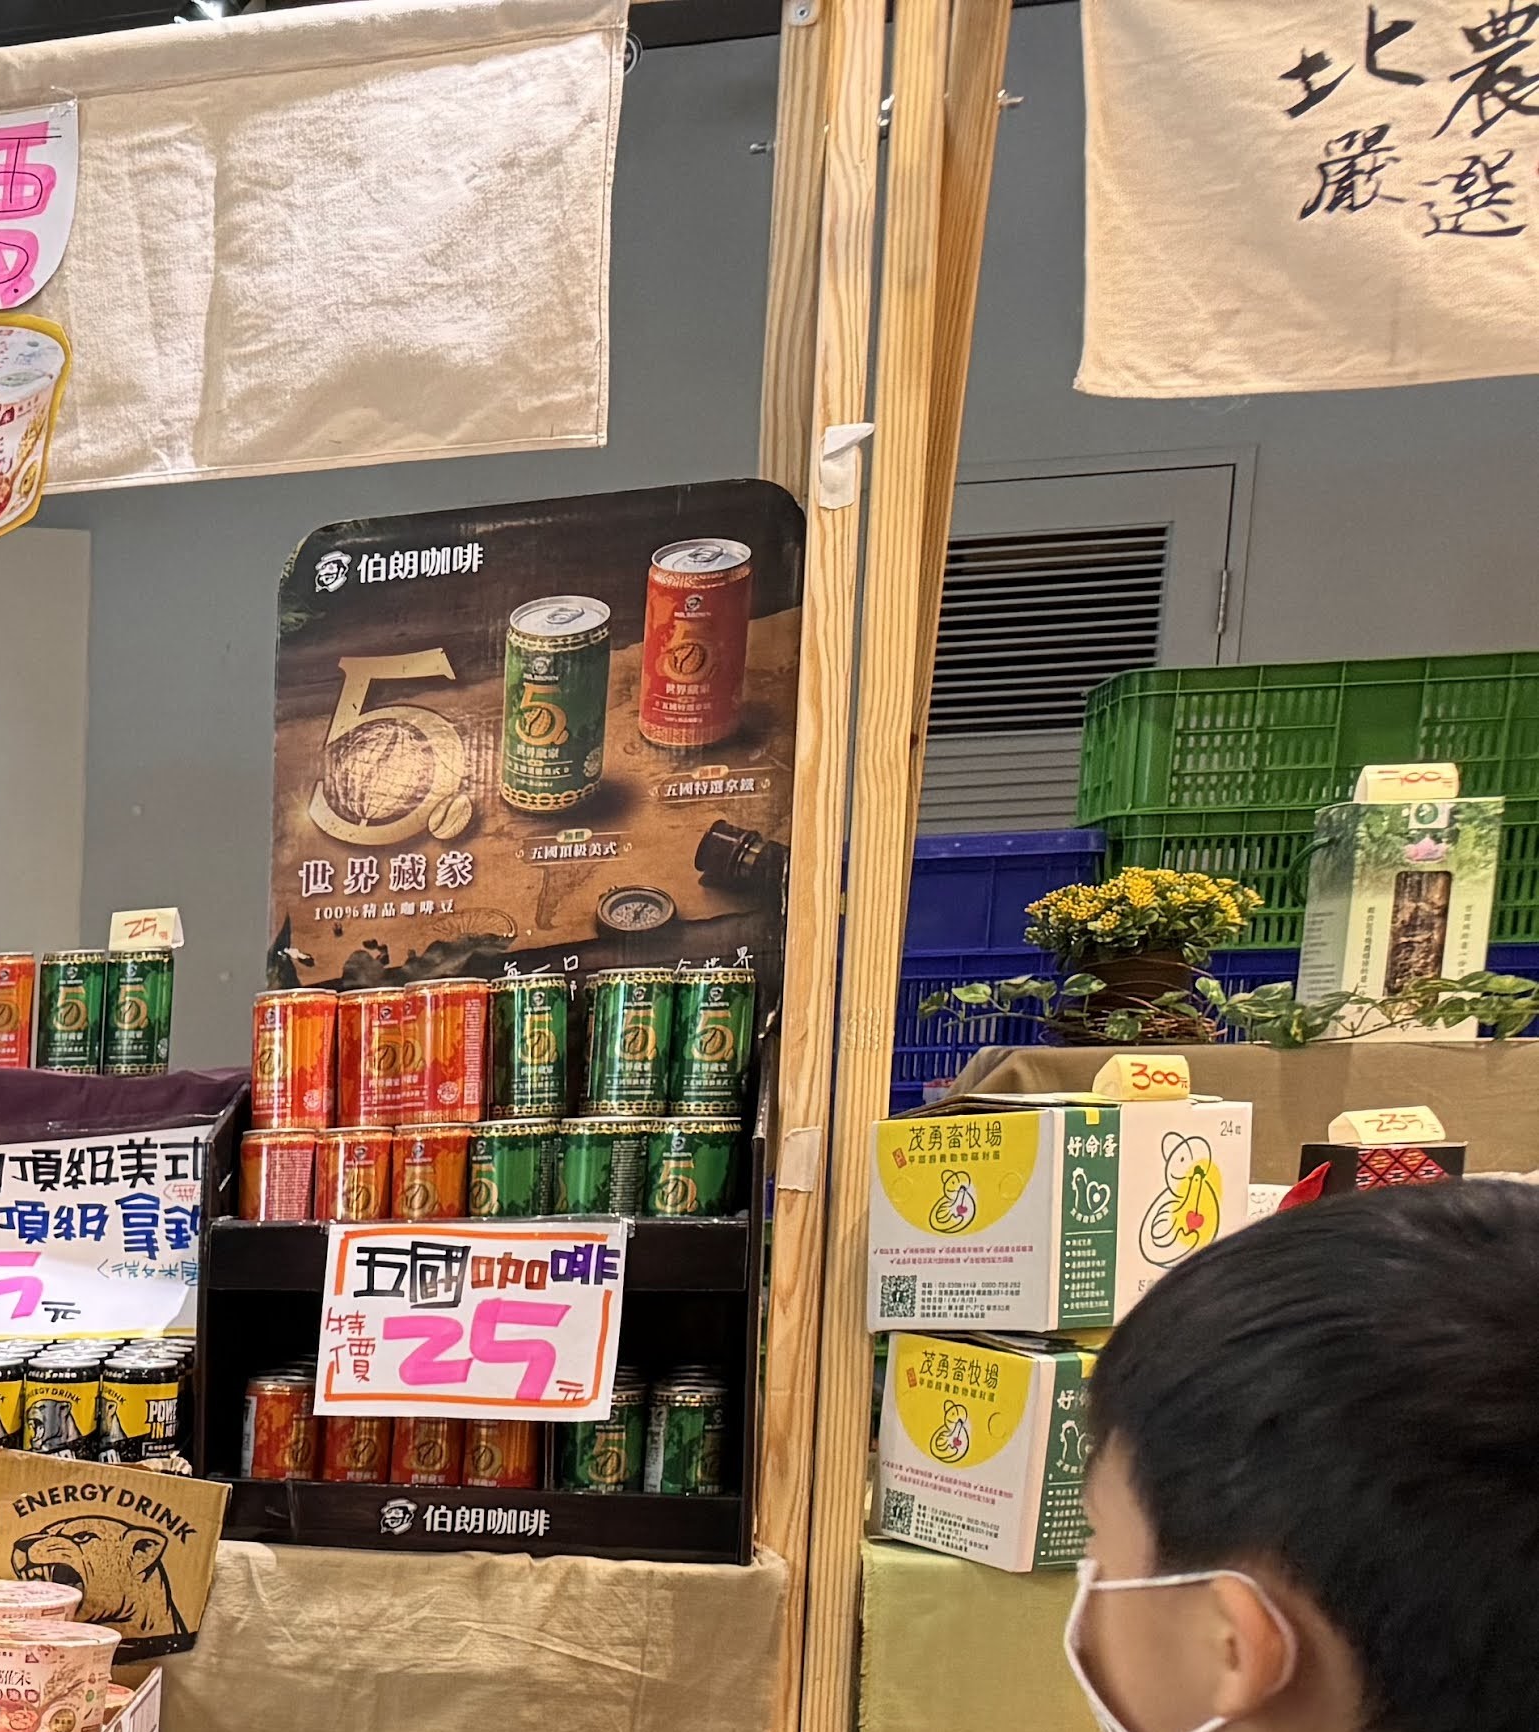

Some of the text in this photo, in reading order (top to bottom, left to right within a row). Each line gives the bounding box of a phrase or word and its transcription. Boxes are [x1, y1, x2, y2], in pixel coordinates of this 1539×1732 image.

[1299, 124, 1528, 239] 嚴選
[357, 543, 484, 585] 伯朗咖啡
[298, 851, 474, 897] 世界藏家
[908, 1121, 1002, 1152] 茂勇畜牧場
[354, 1240, 620, 1309] 五國咖啡
[325, 1307, 377, 1383] 特價
[919, 1351, 999, 1389] 茂勇畜牧場
[12, 1483, 197, 1544] ENERGY DRINK
[423, 1504, 551, 1537] 伯朗咖啡
